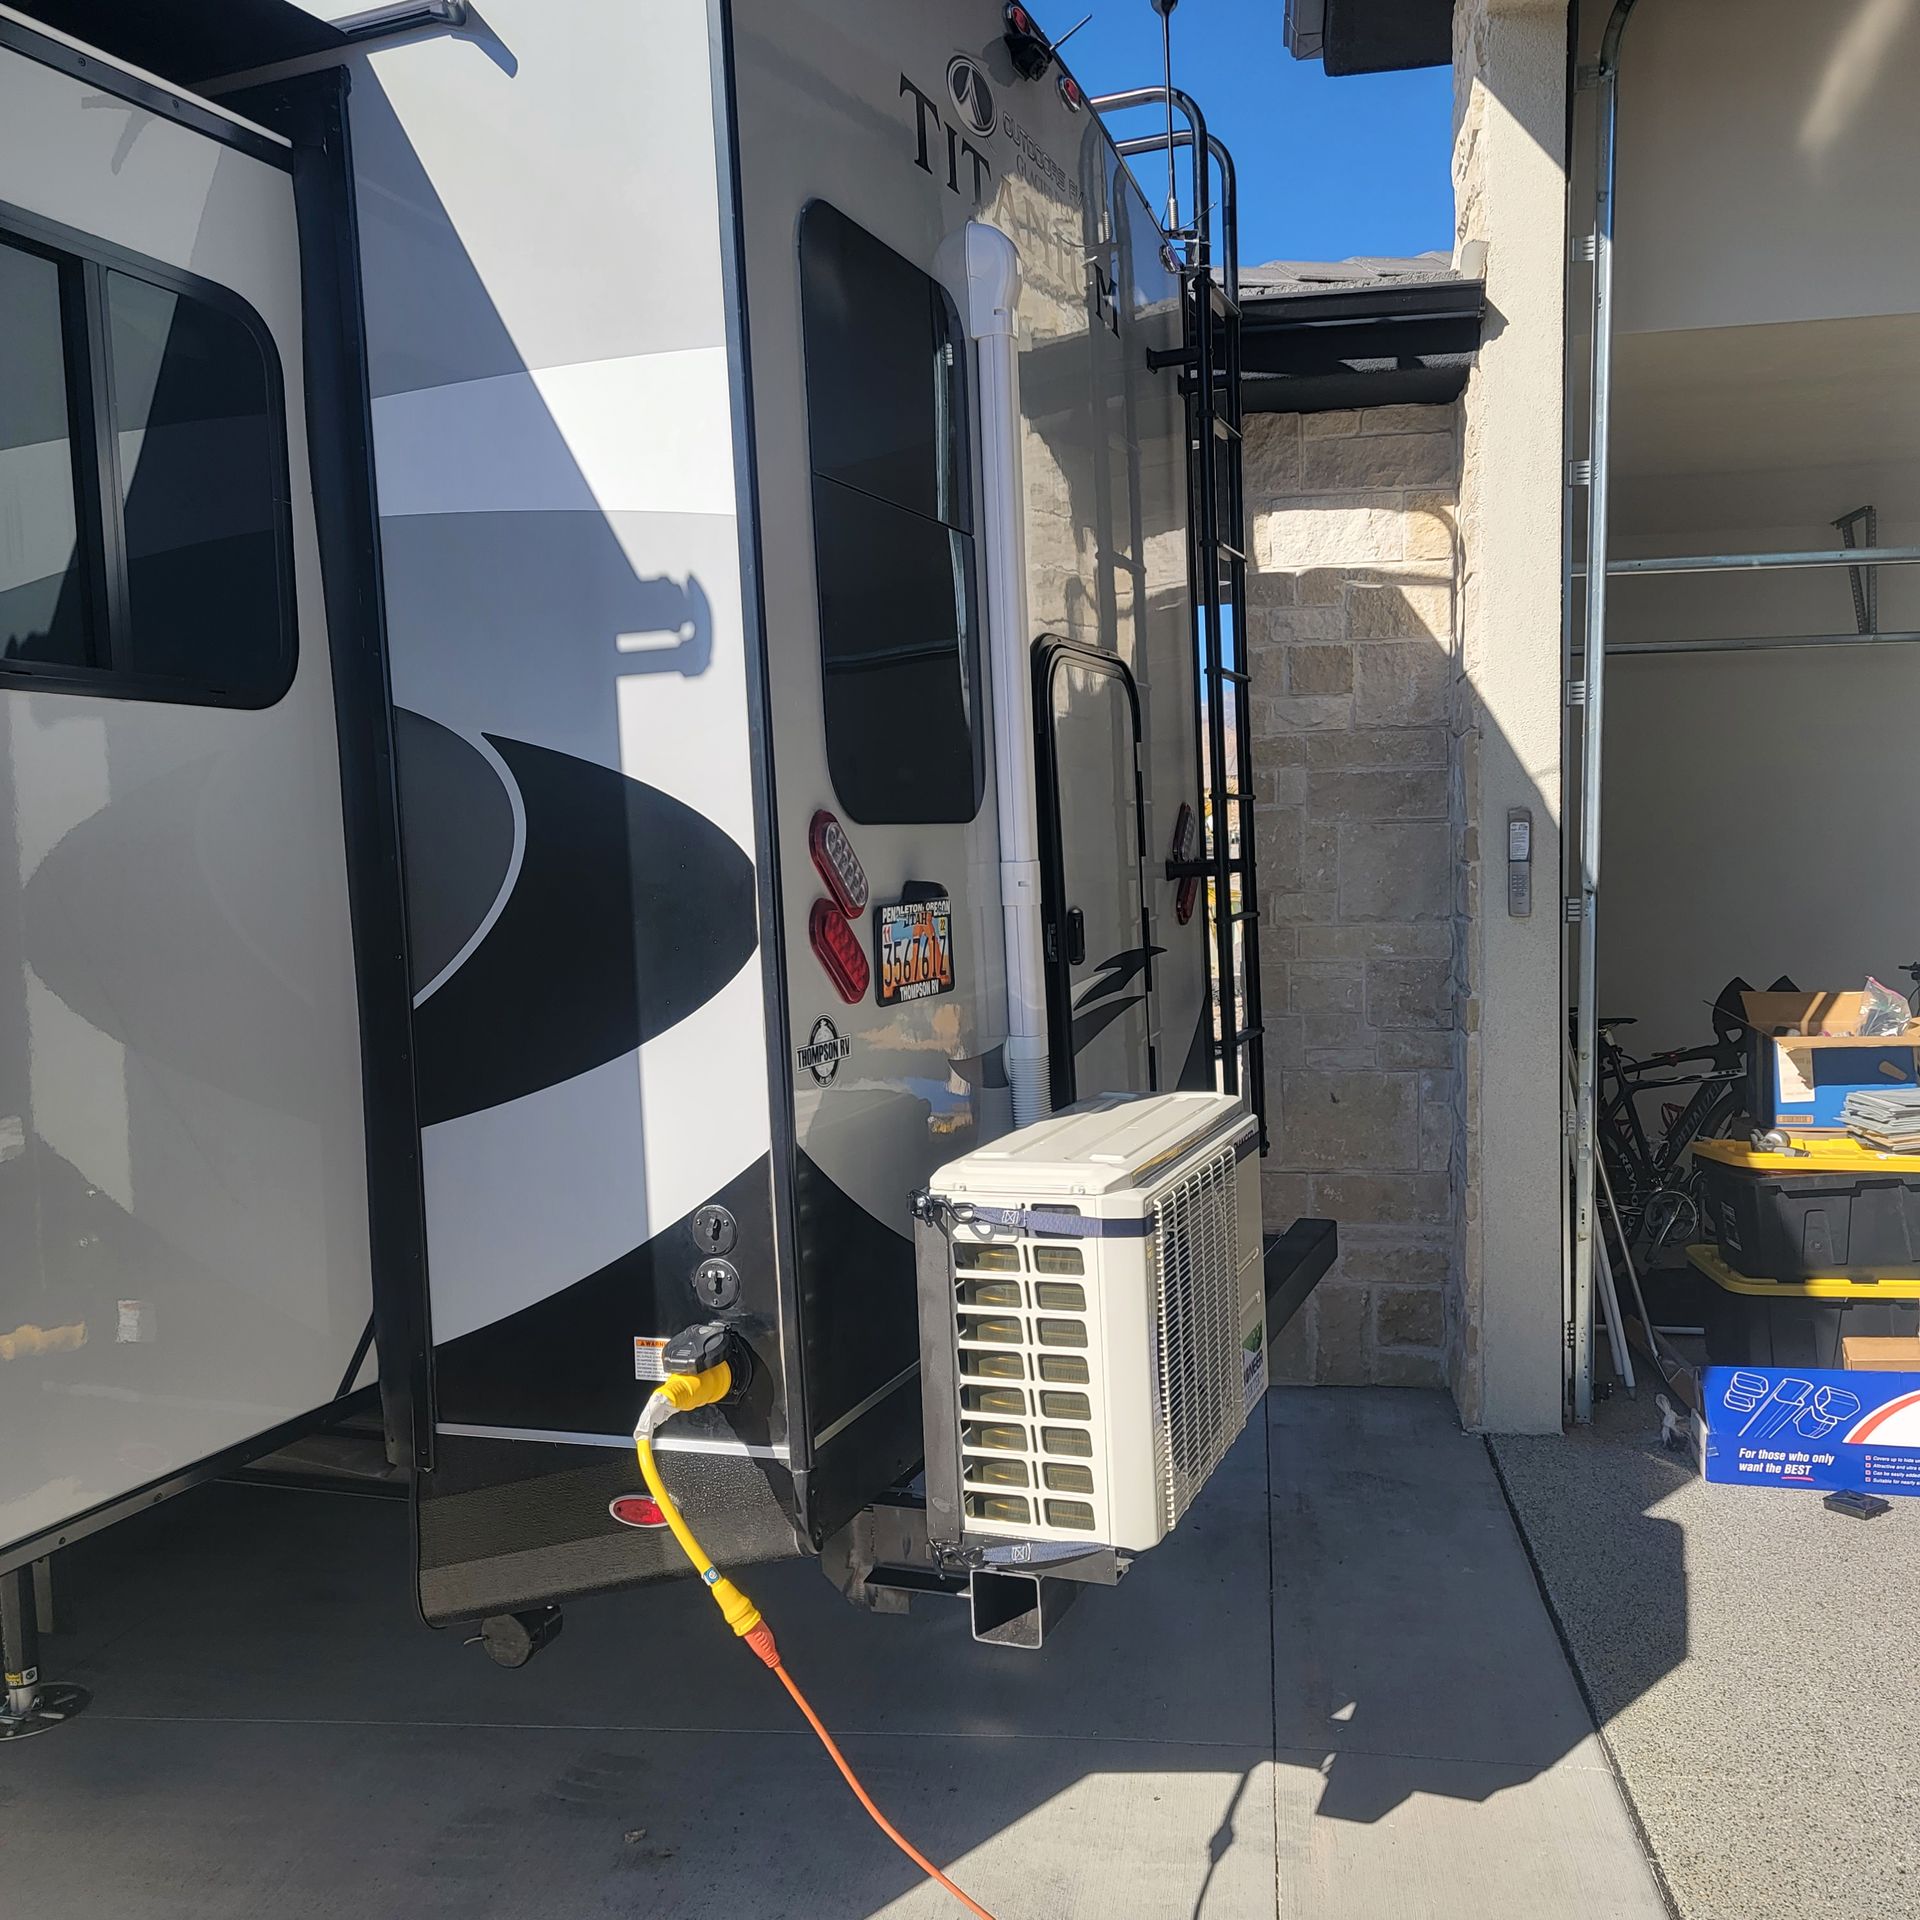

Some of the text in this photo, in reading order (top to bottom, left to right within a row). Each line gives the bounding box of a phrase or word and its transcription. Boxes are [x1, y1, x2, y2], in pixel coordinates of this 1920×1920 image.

[1003, 111, 1084, 207] OUTDOORS RV
[926, 900, 951, 916] OREGON
[883, 926, 891, 943] 11
[900, 979, 940, 1001] THOMPSON RV
[797, 1037, 850, 1068] THOMPSON RV
[1739, 1448, 1835, 1466] For those who only
[1739, 1463, 1812, 1475] want the BEST
